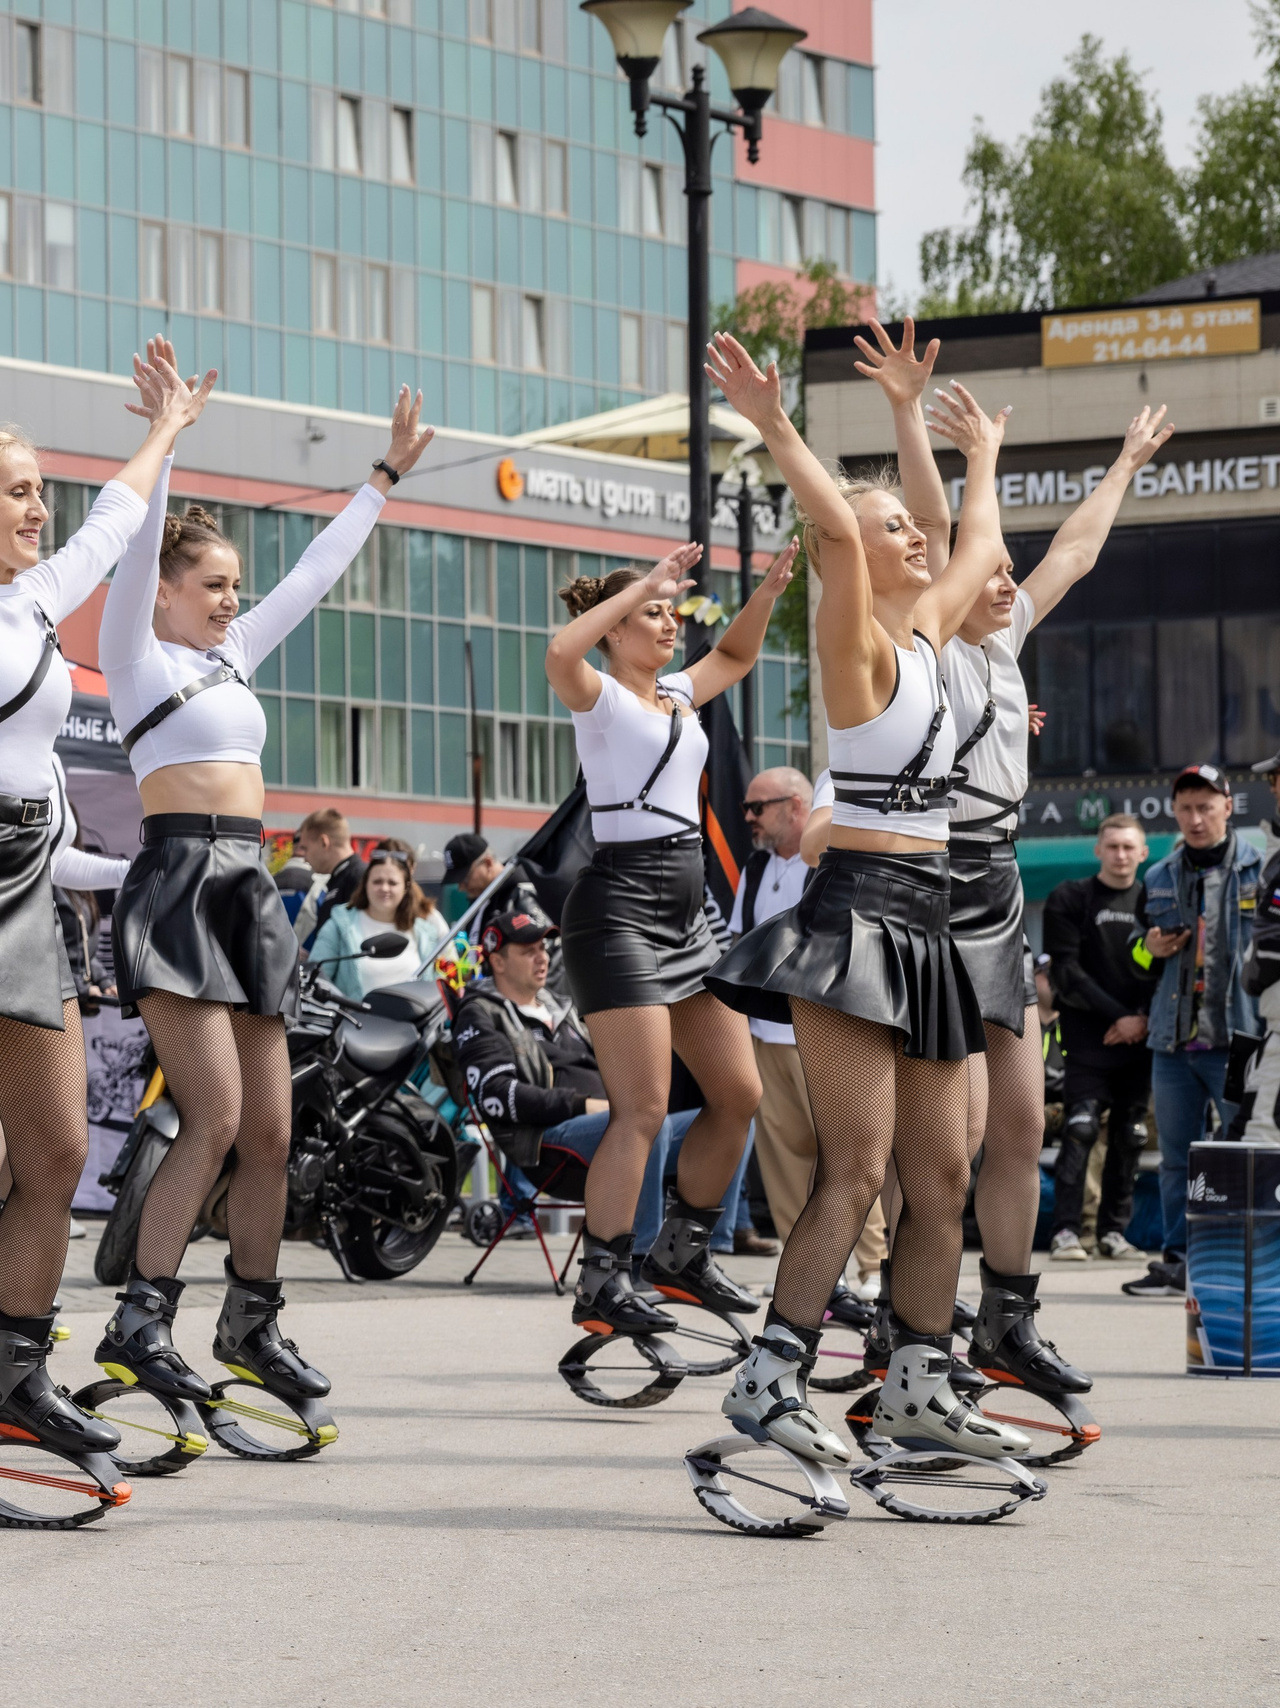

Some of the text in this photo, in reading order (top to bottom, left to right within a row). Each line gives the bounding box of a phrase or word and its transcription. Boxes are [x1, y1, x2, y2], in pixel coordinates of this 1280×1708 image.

[1048, 317, 1140, 342] Аренда
[1192, 307, 1254, 328] этаж
[1092, 333, 1208, 362] 214-64-44
